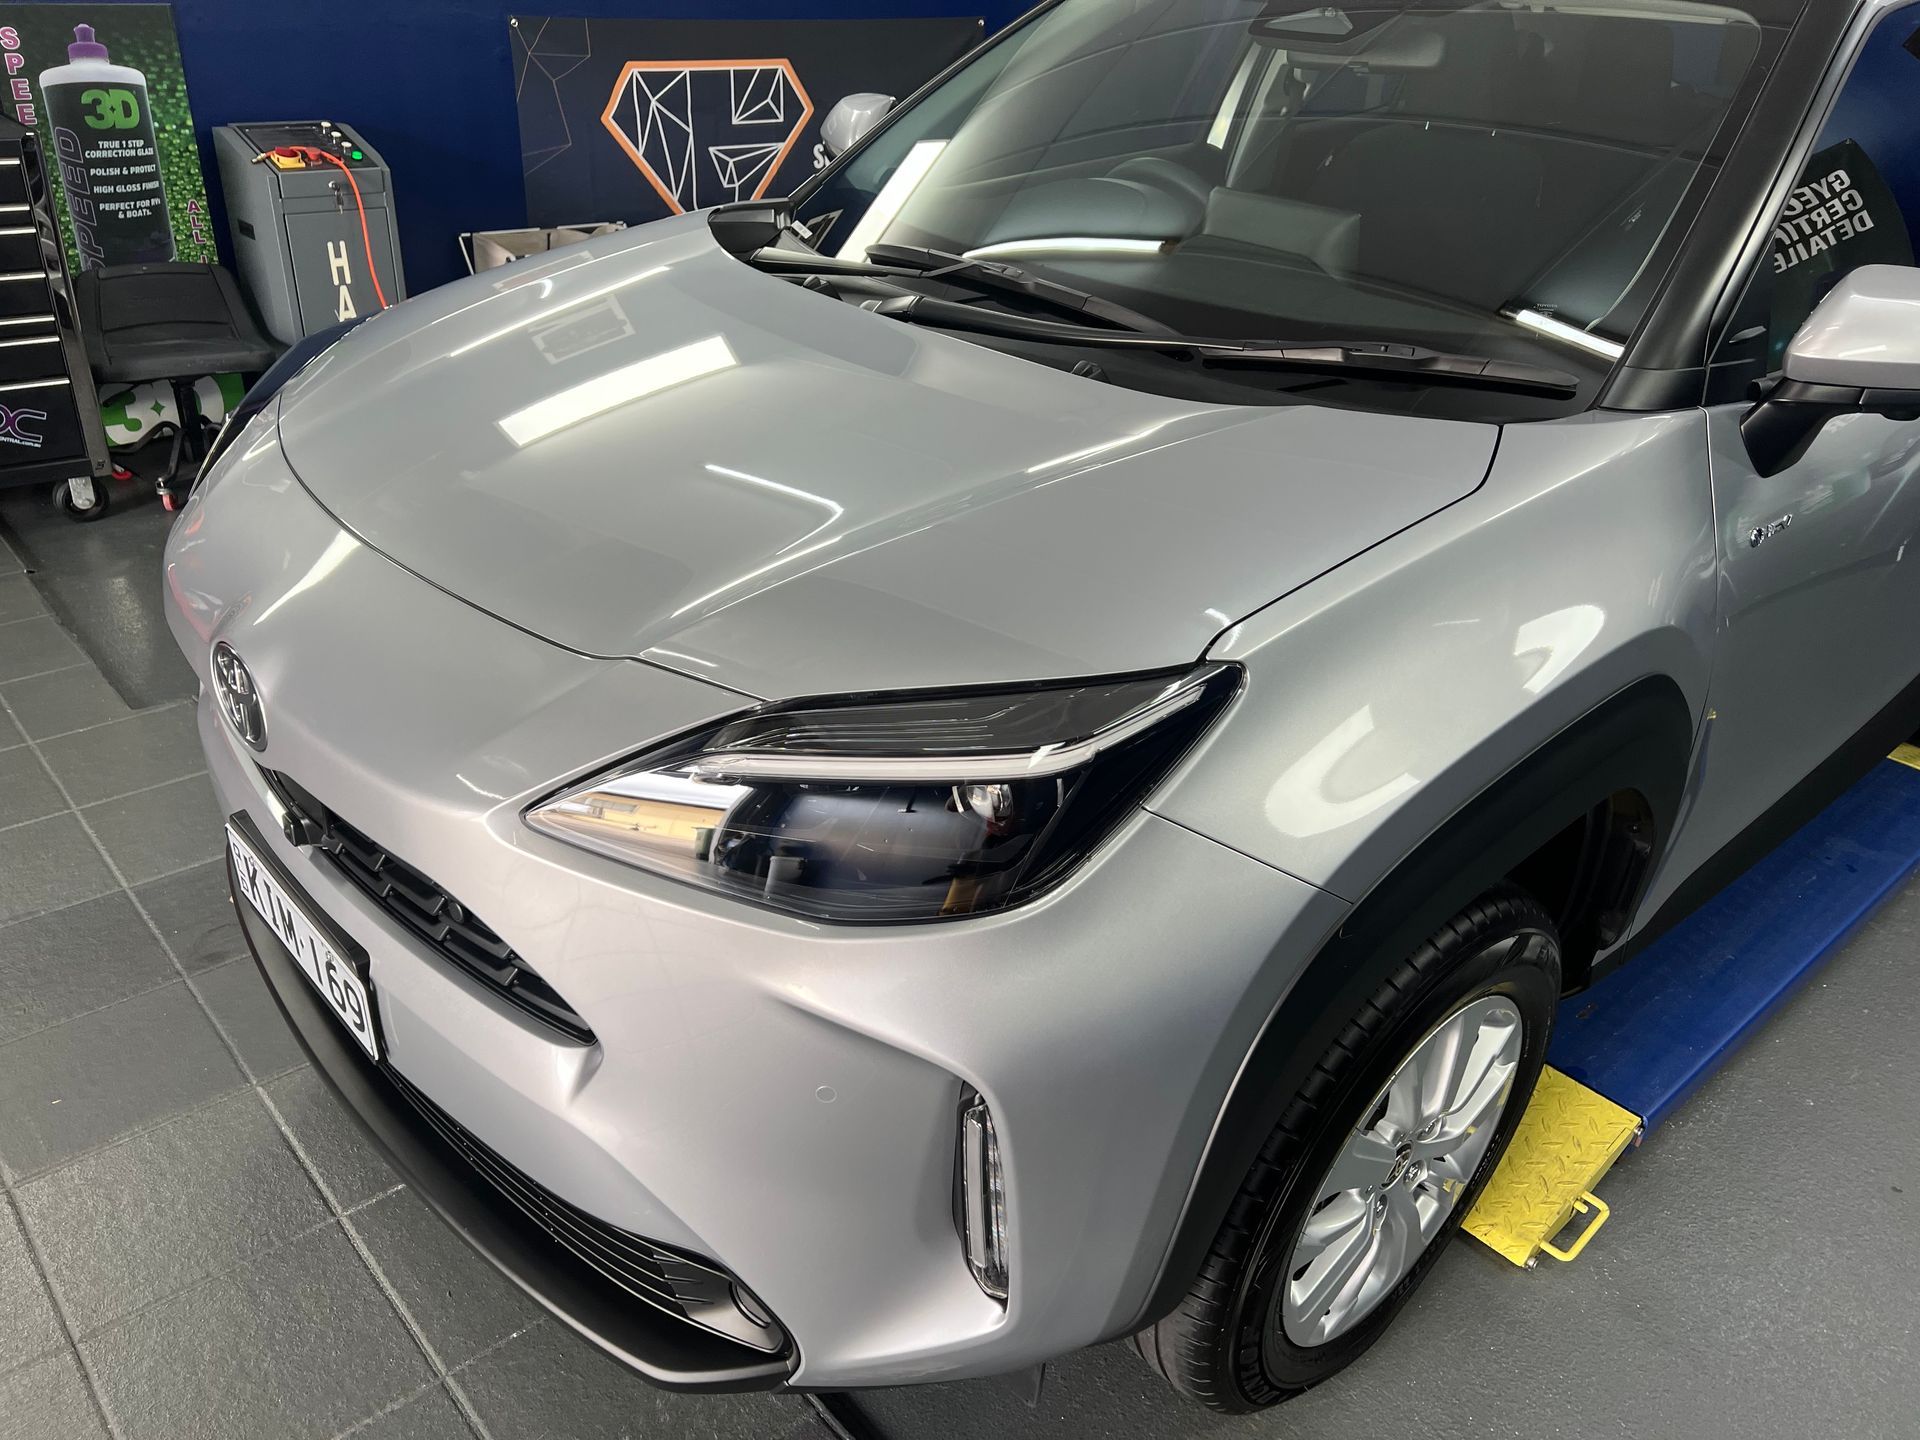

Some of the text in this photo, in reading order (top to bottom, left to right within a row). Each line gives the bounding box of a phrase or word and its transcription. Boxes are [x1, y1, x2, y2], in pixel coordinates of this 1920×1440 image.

[80, 88, 141, 130] 3D
[98, 139, 145, 149] TRUE 1 STEP
[85, 149, 136, 158] CORRECTION
[813, 143, 831, 169] S
[90, 164, 156, 176] POLISH & PROTECT
[93, 185, 114, 194] HIGH
[116, 183, 141, 193] GLOSS
[99, 201, 135, 211] PERFECT
[136, 199, 150, 209] FOR
[118, 211, 125, 219] &
[187, 199, 207, 244] ALL
